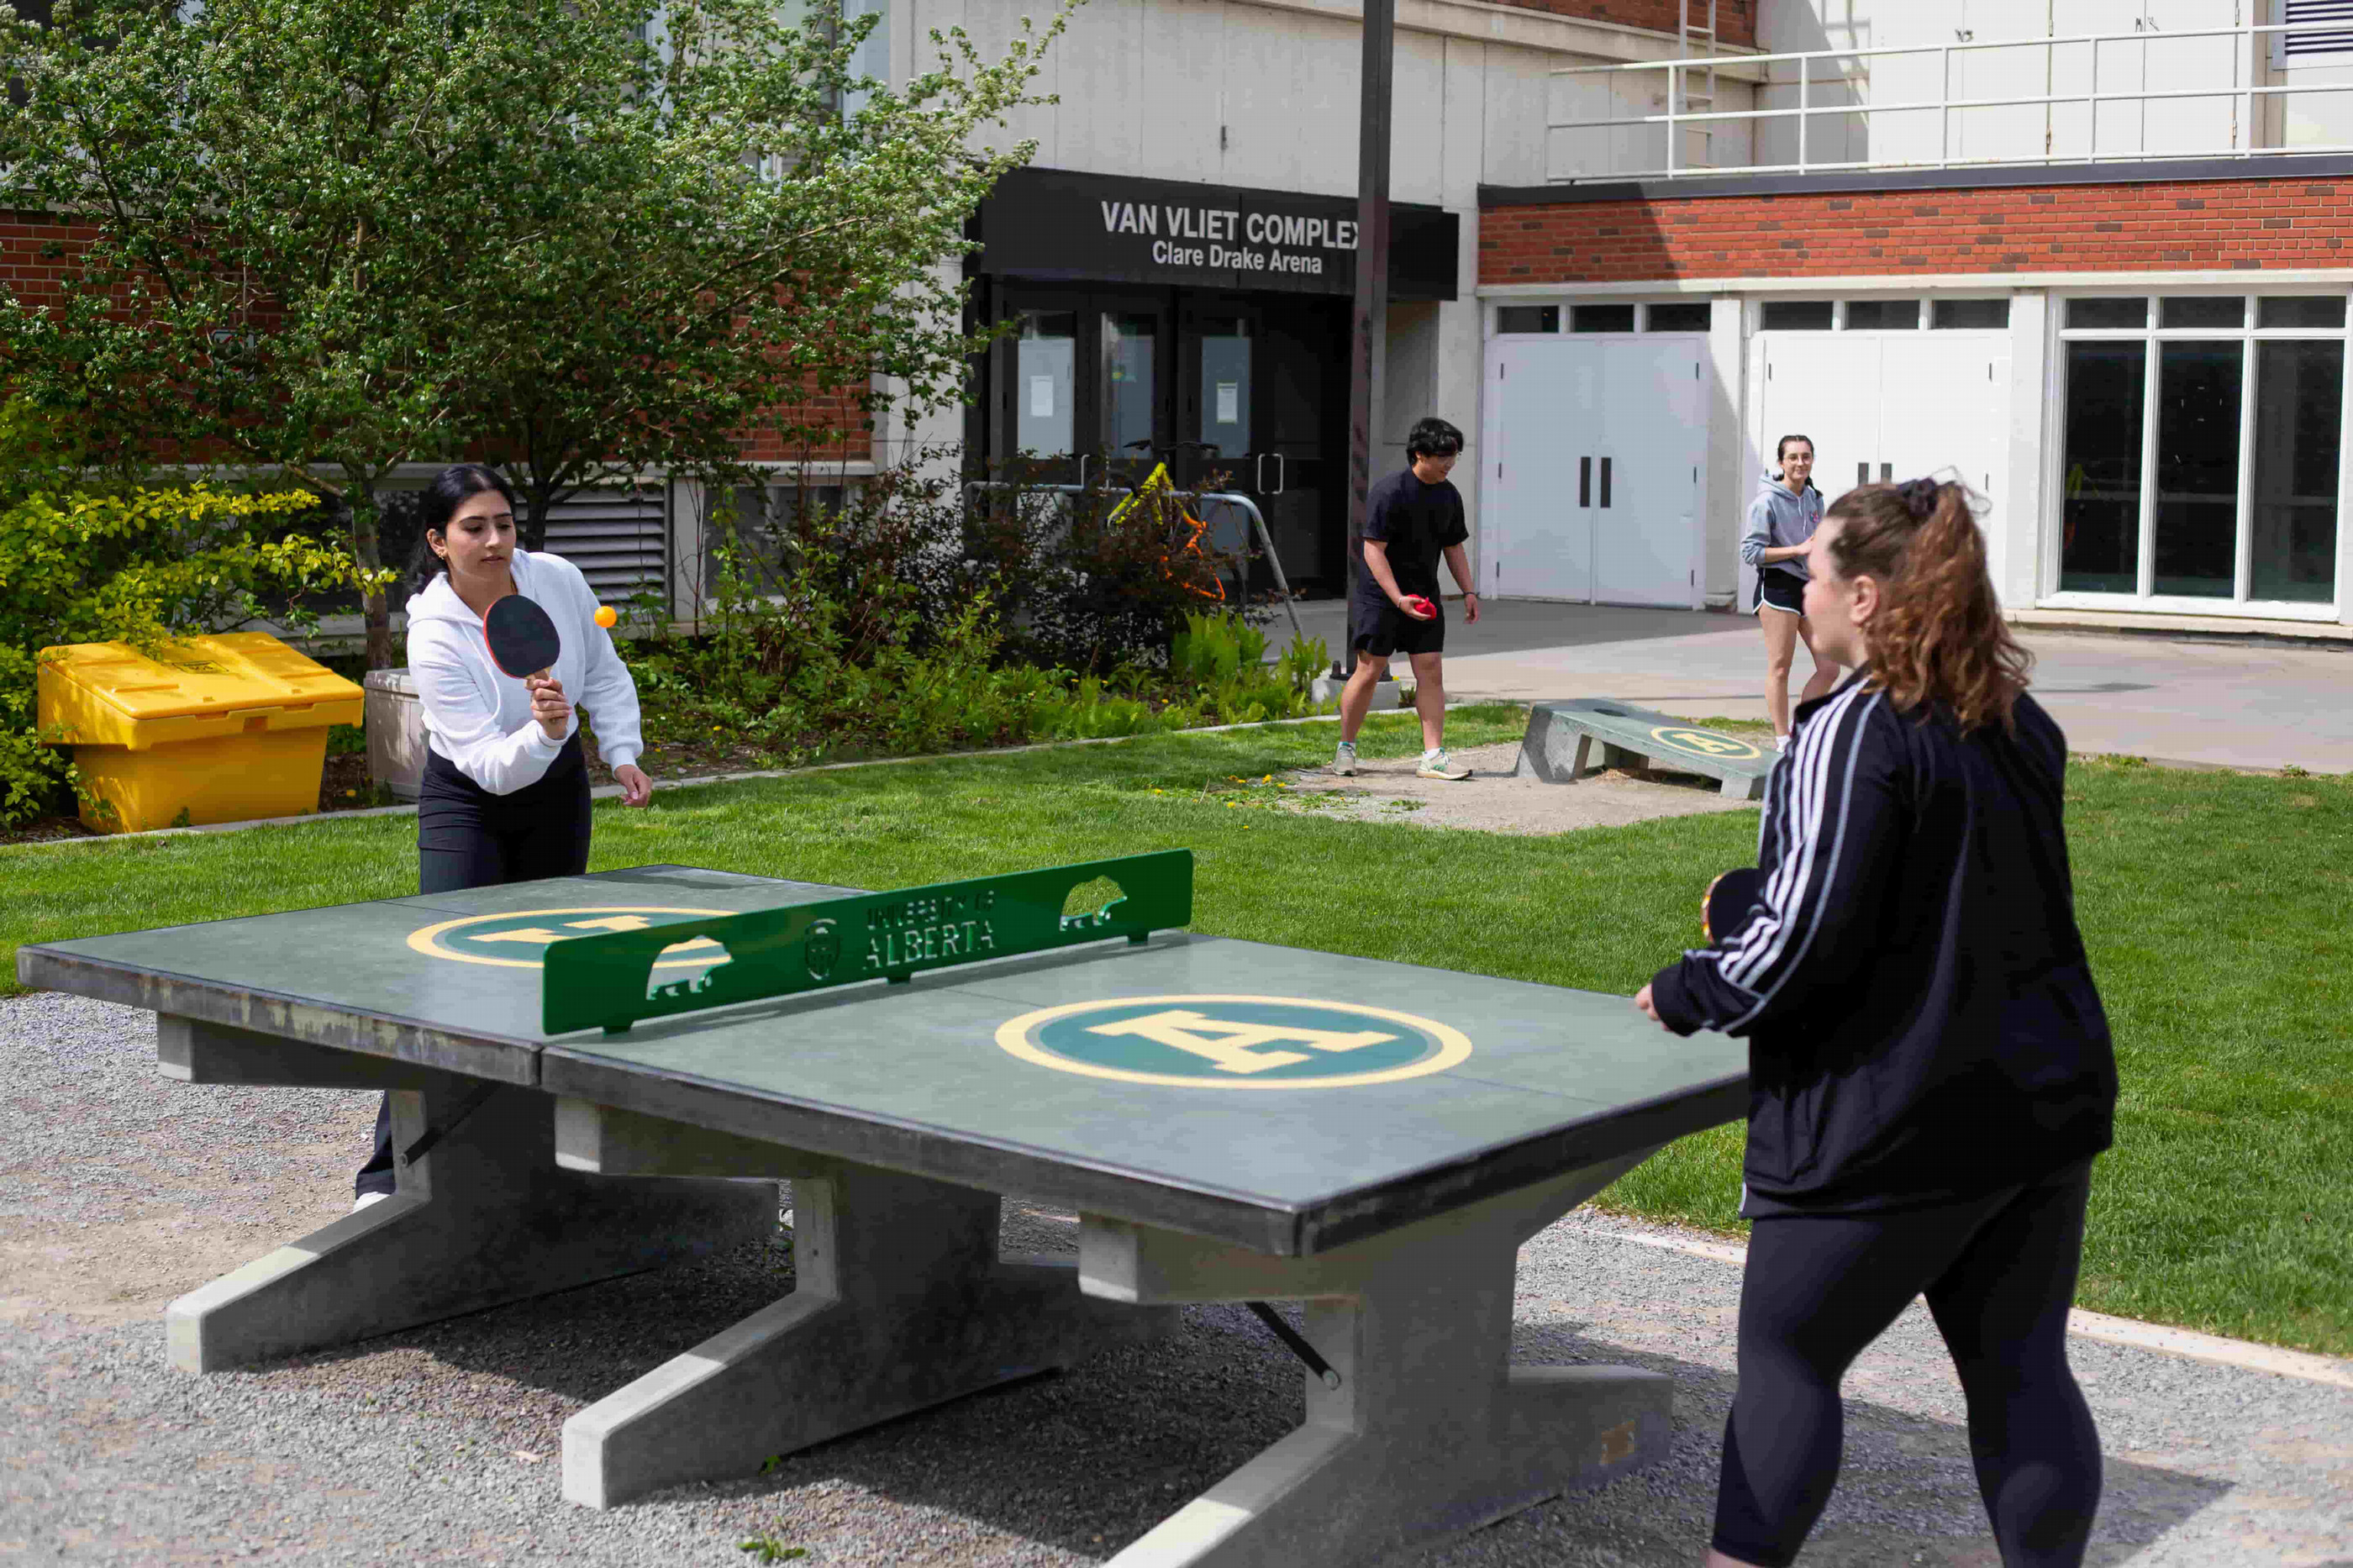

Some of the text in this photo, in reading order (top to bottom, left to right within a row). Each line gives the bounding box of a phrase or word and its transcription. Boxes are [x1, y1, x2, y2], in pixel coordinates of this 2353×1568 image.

[1102, 201, 1157, 234] VAN
[1166, 206, 1239, 241] VLIET
[1152, 240, 1323, 274] Clare Drake Arena
[862, 919, 998, 971] ALBERTA
